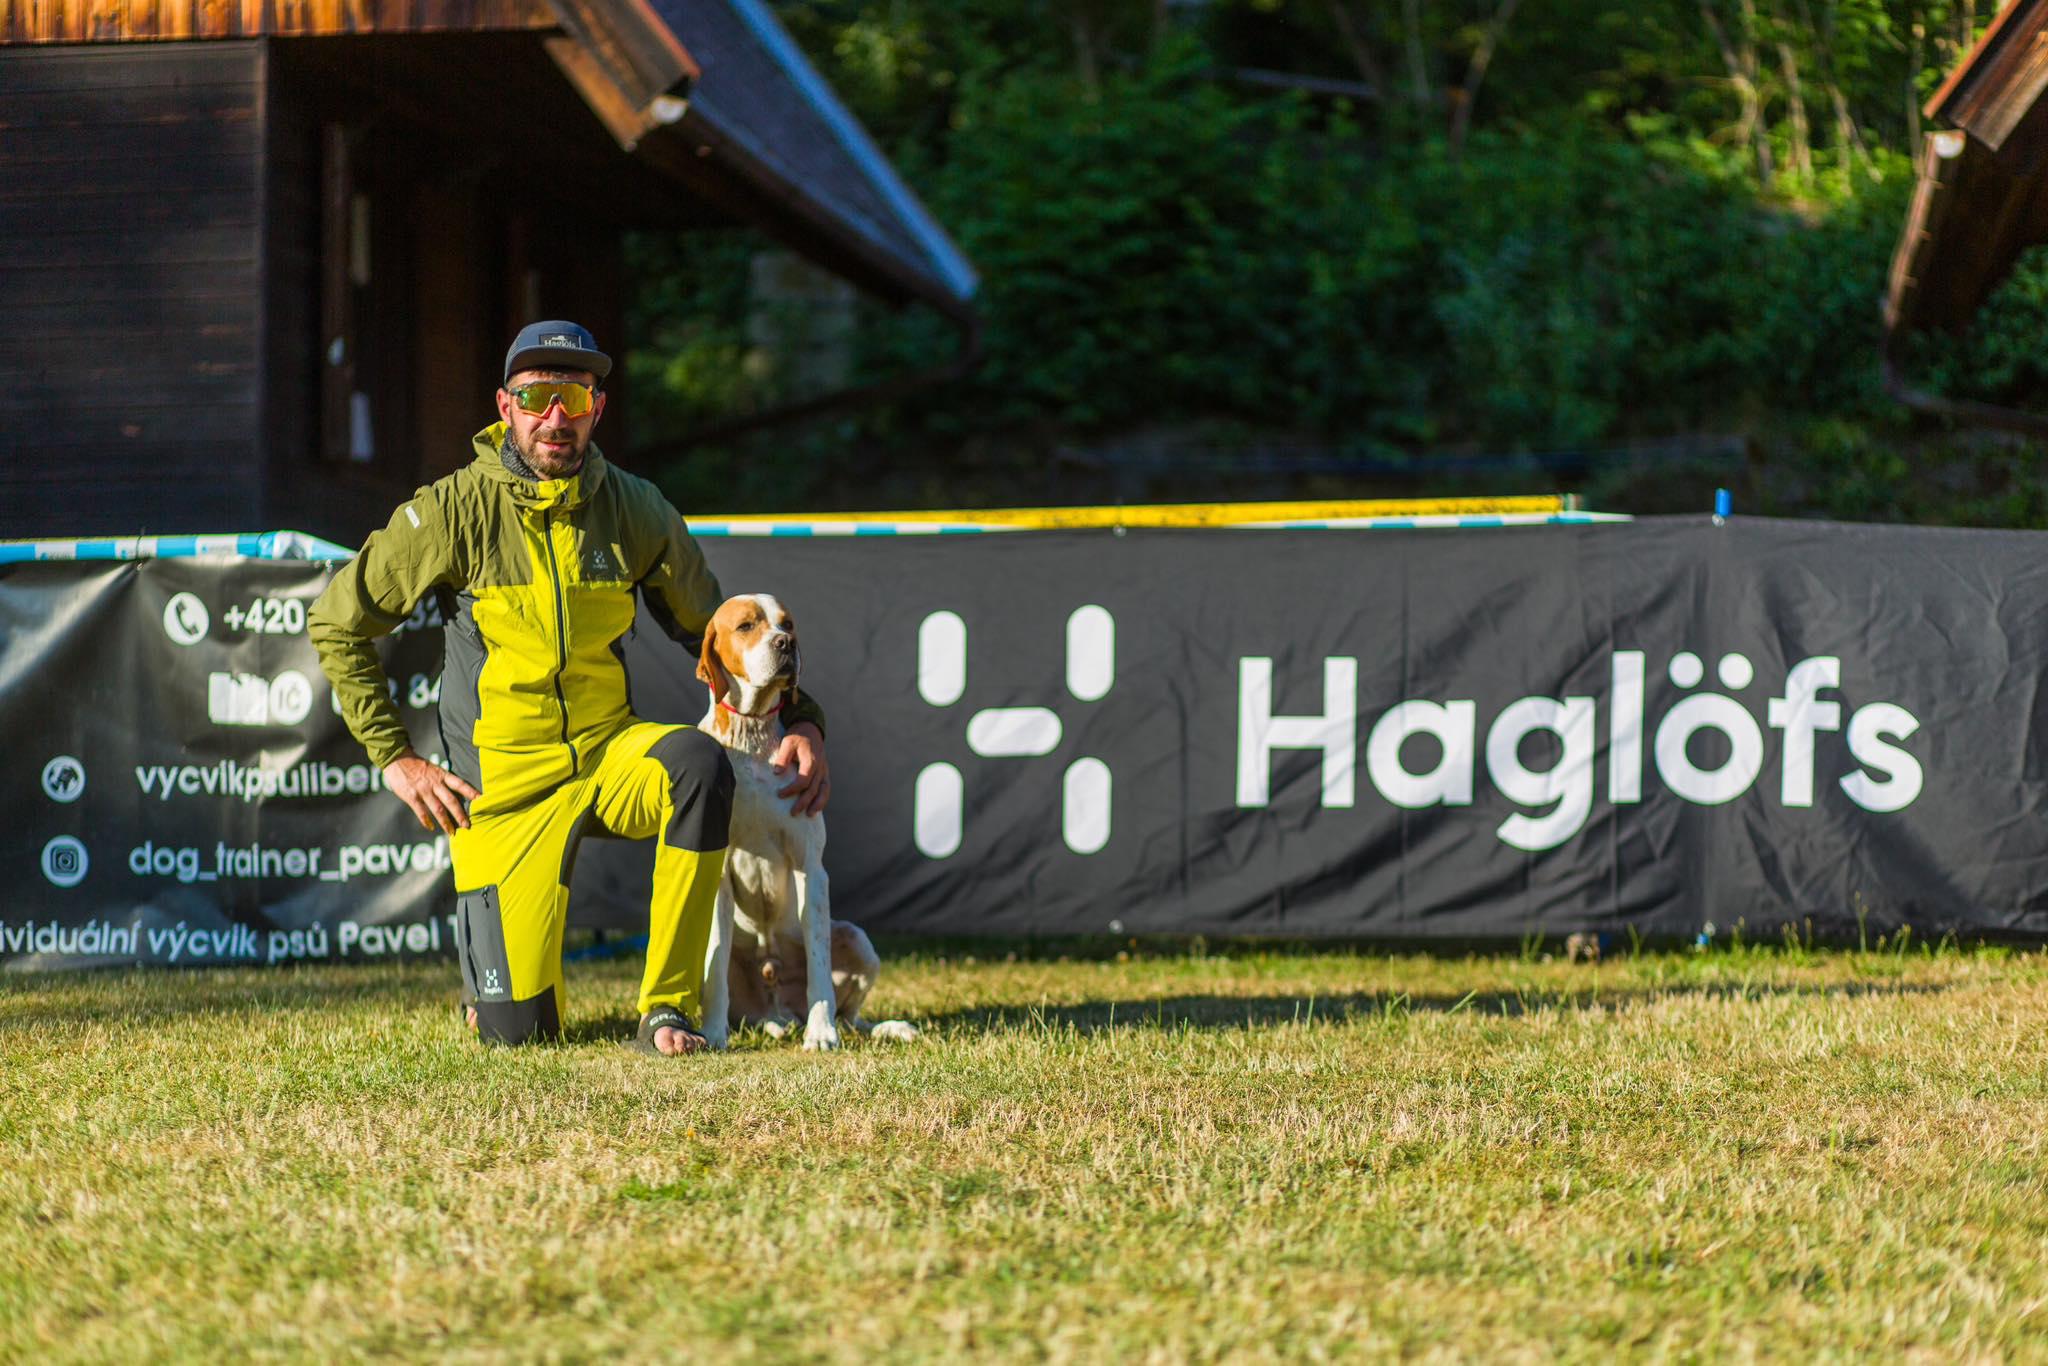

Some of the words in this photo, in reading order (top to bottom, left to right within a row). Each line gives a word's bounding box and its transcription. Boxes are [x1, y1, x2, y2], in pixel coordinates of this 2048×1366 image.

[223, 597, 305, 634] +420
[1235, 650, 1924, 851] Haglöfs
[135, 758, 393, 801] vycvikpsuliber
[148, 919, 258, 962] výcvik
[267, 920, 329, 964] psů
[338, 915, 440, 956] Pavel
